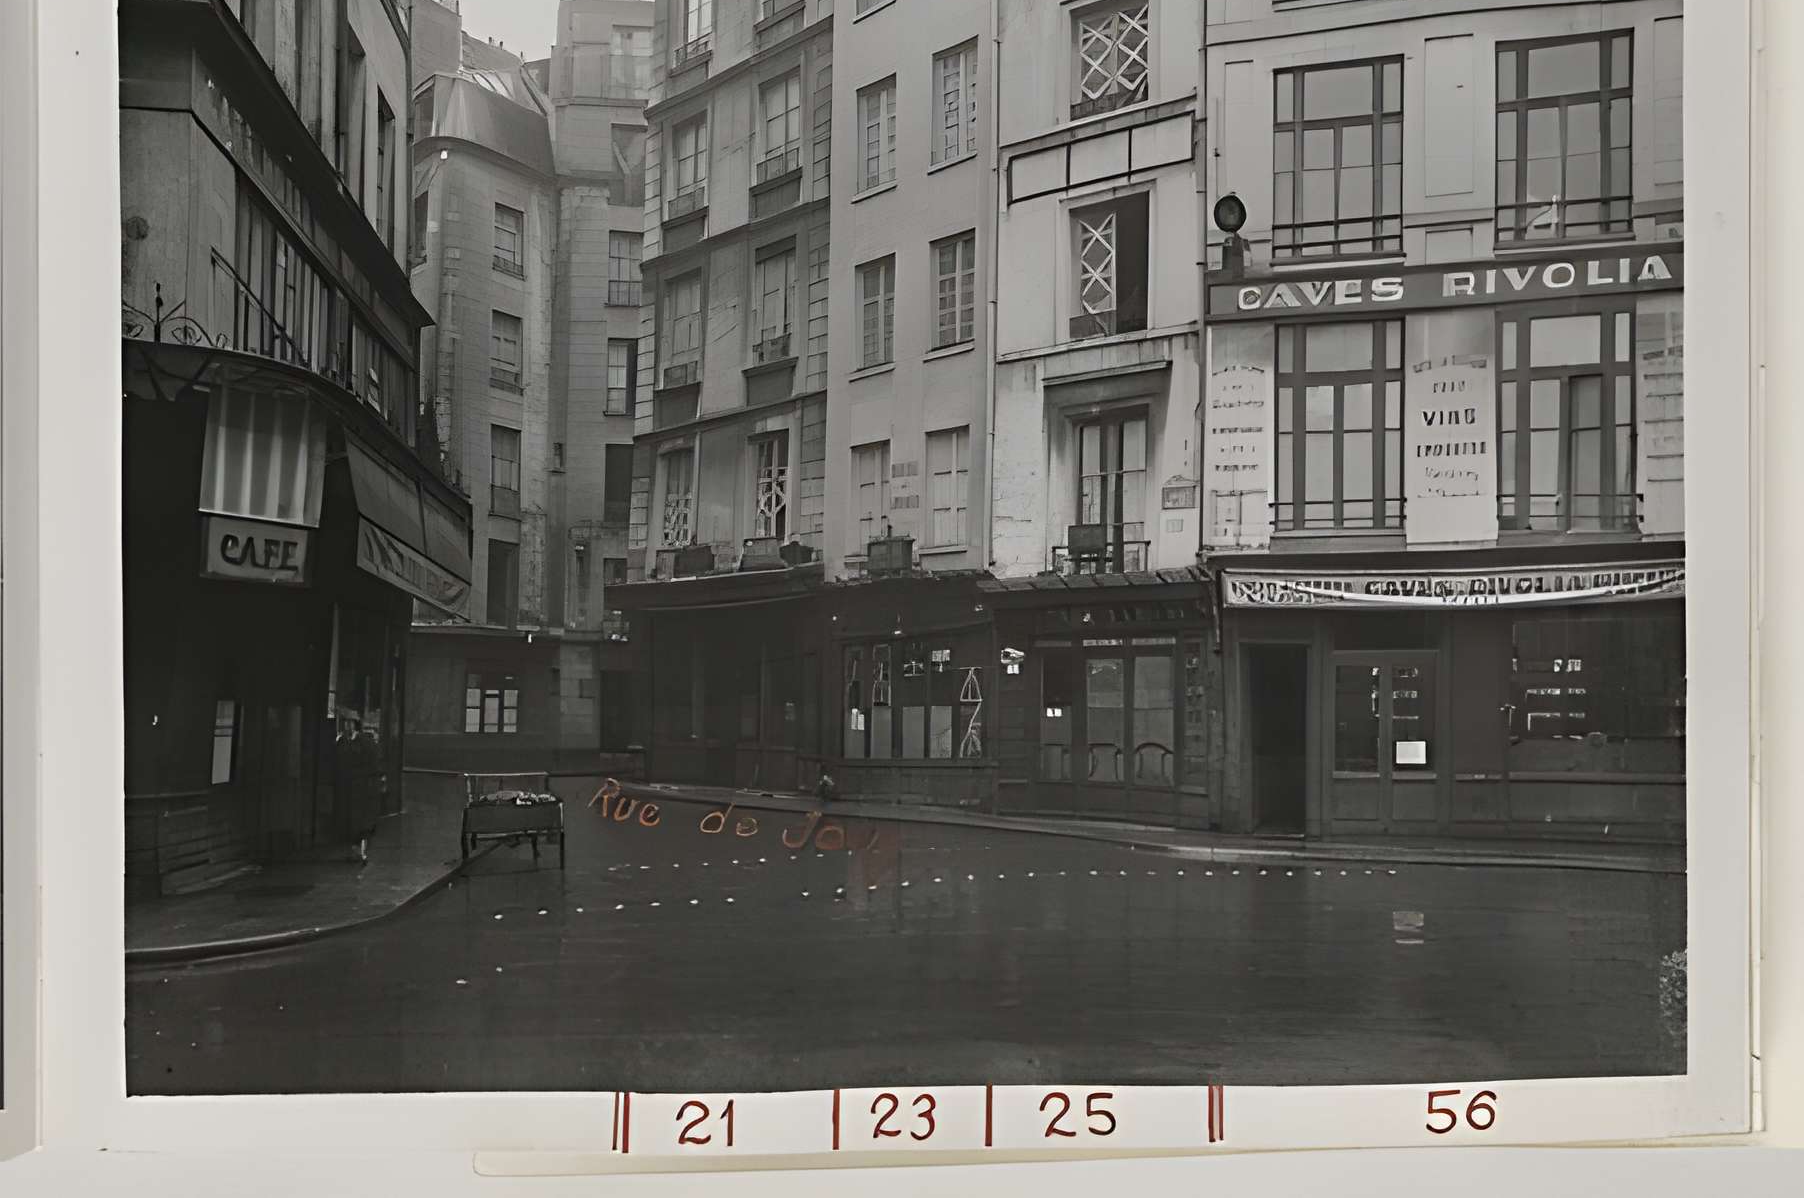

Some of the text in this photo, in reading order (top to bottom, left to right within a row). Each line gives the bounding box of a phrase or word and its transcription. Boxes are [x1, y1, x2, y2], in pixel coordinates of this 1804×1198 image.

[1239, 255, 1672, 310] CAVES RIVOLIA
[587, 777, 661, 826] Rue
[699, 802, 758, 836] de
[675, 1099, 734, 1146] 21
[870, 1092, 936, 1141] 23
[1039, 1091, 1117, 1138] 25
[1425, 1089, 1497, 1135] 56
